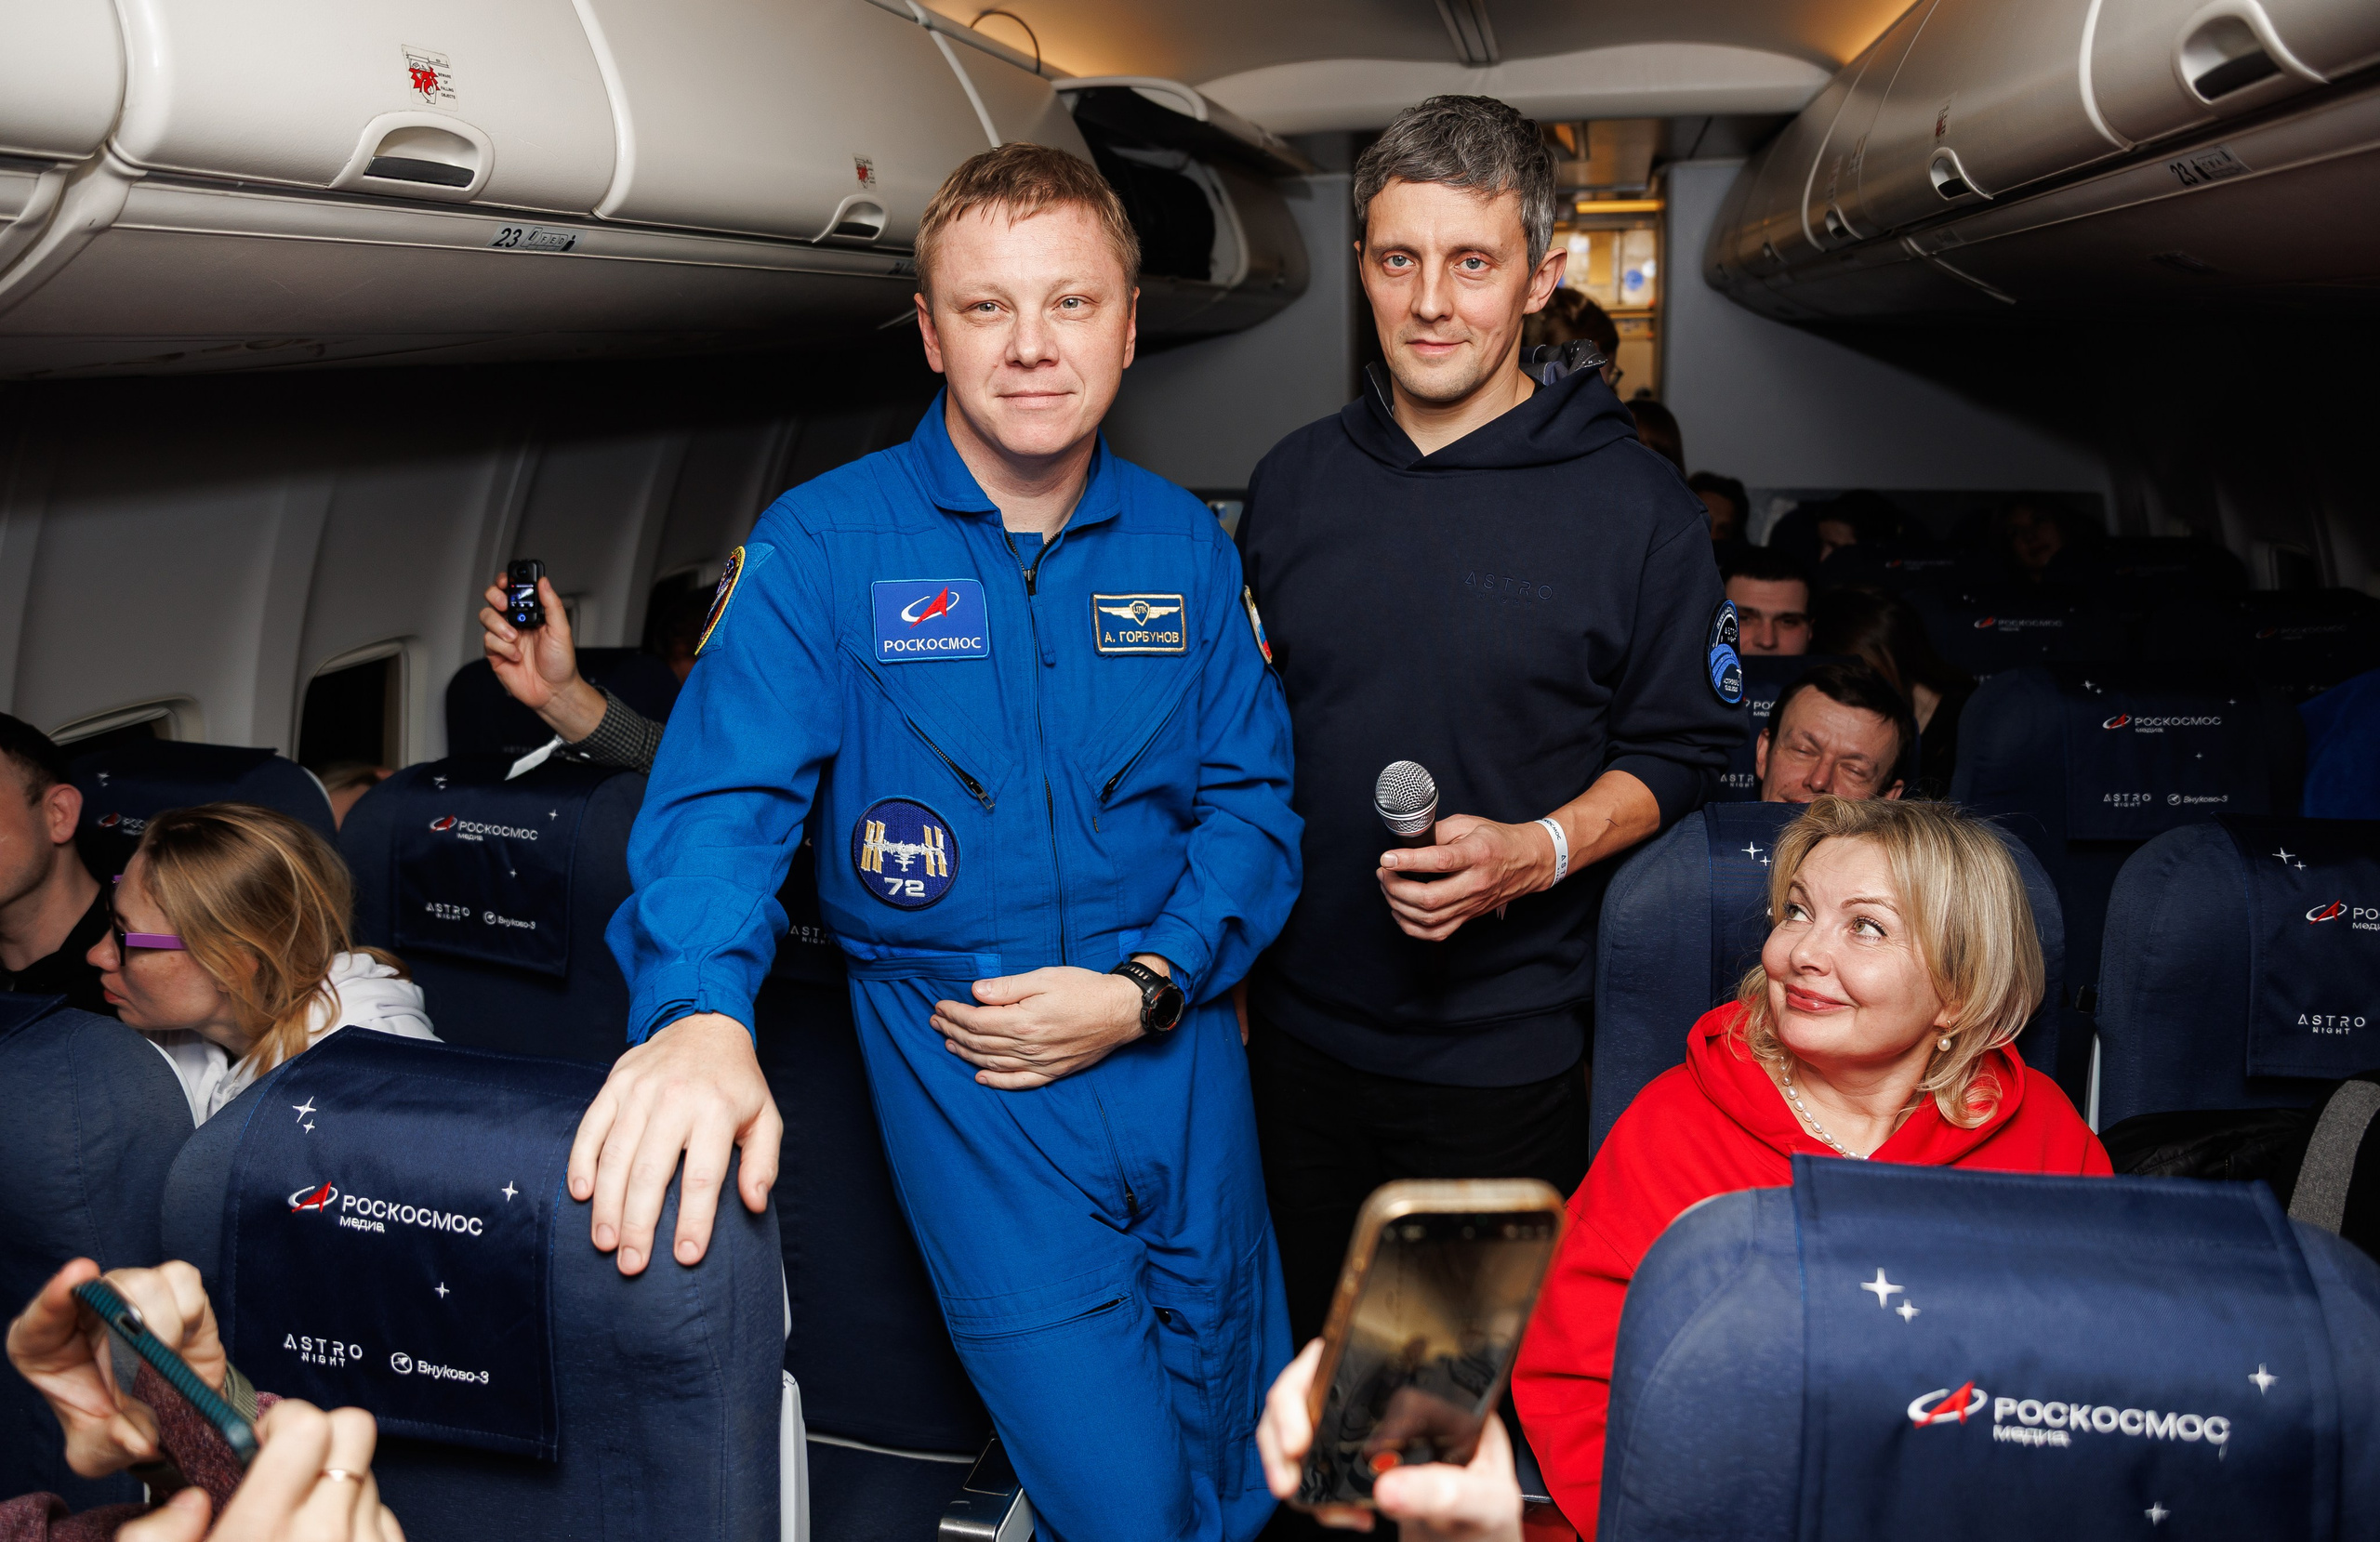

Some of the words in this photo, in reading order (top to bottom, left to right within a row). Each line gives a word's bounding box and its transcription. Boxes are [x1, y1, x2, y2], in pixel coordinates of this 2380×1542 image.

[2170, 162, 2199, 186] 23
[492, 228, 522, 248] 23
[1464, 571, 1553, 600] ASTRO
[883, 637, 982, 652] РОСКОСМОС
[1104, 631, 1116, 643] А.
[1118, 630, 1180, 643] ГОРБУНОВ
[2135, 716, 2222, 726] РОСКОСМОС
[1720, 774, 1754, 783] ASTR
[2103, 793, 2152, 802] ASTRO
[457, 821, 538, 840] РОСКОСМОС
[884, 876, 926, 898] 72
[426, 902, 470, 916] ASTRO
[790, 925, 826, 939] AST
[2297, 1013, 2366, 1028] ASTRO
[2312, 1026, 2350, 1035] NIGHT
[339, 1215, 385, 1233] медиа
[342, 1194, 483, 1236] РОСКОСМОС
[284, 1333, 363, 1360] ASTRO
[301, 1351, 346, 1368] NIGHT
[417, 1360, 489, 1385] Внуково-3
[1994, 1396, 2231, 1446] РОСКОСМОС
[1993, 1424, 2071, 1449] медиа
